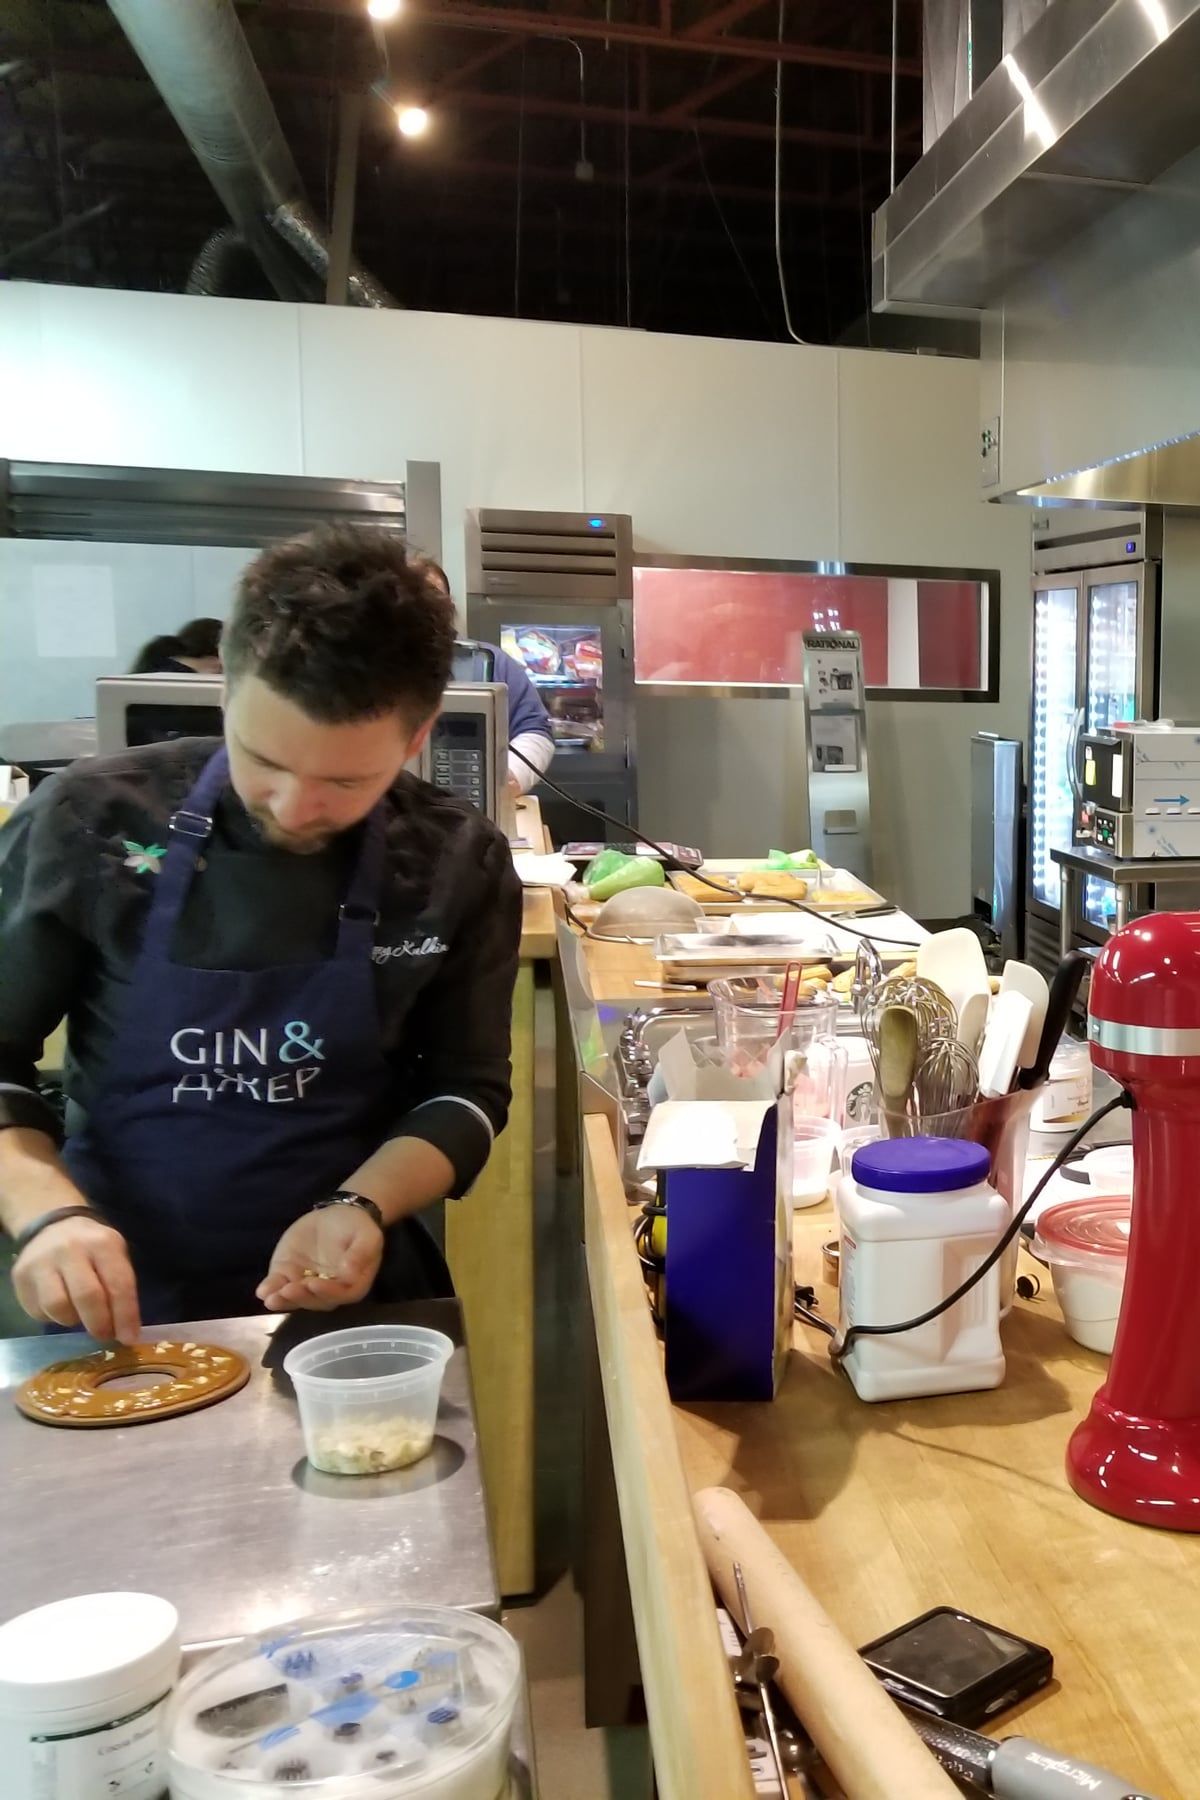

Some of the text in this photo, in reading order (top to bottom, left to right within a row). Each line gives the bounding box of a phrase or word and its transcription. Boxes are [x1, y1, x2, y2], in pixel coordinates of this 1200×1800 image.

[806, 639, 857, 650] RATIONAL
[172, 1066, 321, 1103] ДЖЕР
[1024, 1752, 1103, 1791] Microplane
